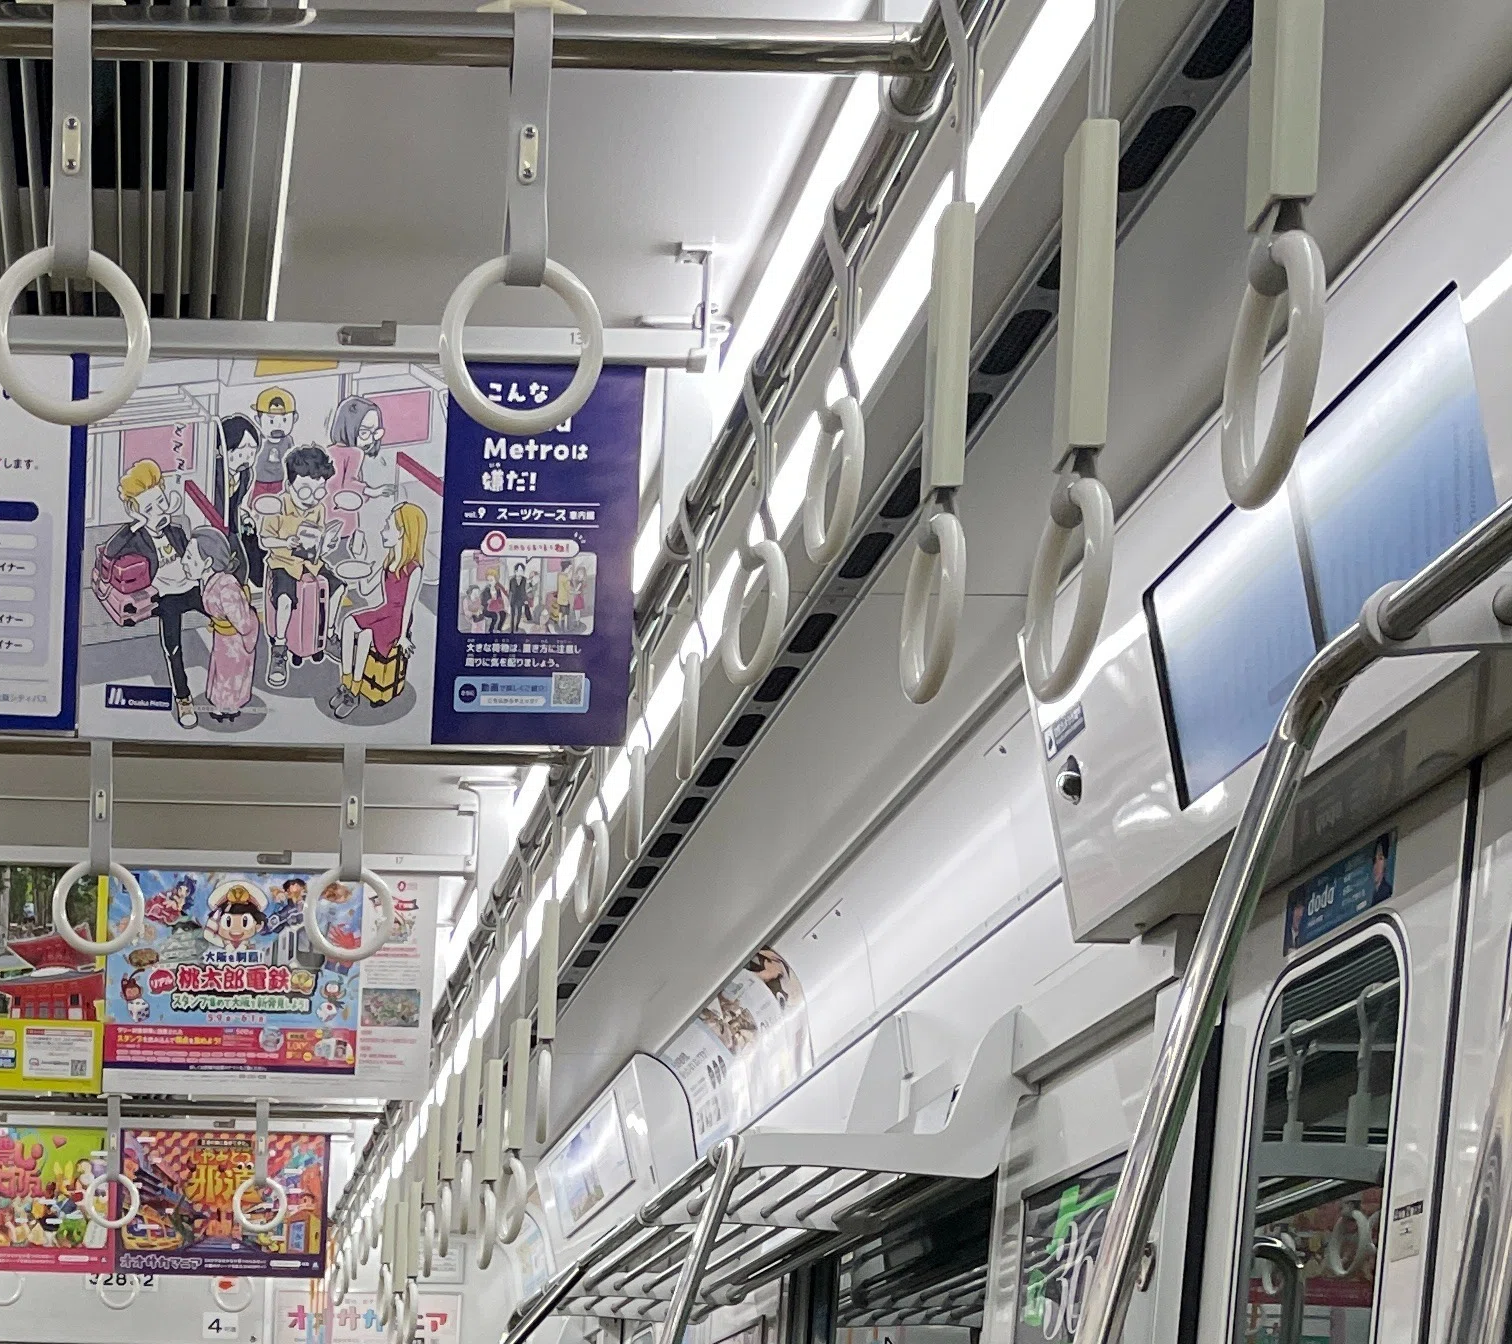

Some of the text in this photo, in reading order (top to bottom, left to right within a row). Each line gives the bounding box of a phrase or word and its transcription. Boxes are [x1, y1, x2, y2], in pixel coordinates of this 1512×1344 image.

[489, 382, 549, 403] こんな
[483, 438, 589, 461] Metroは
[497, 508, 567, 521] スーツケース
[1307, 882, 1335, 916] doda
[177, 965, 290, 990] 桃太郎電鉄
[119, 1252, 203, 1270] オオサカマニア
